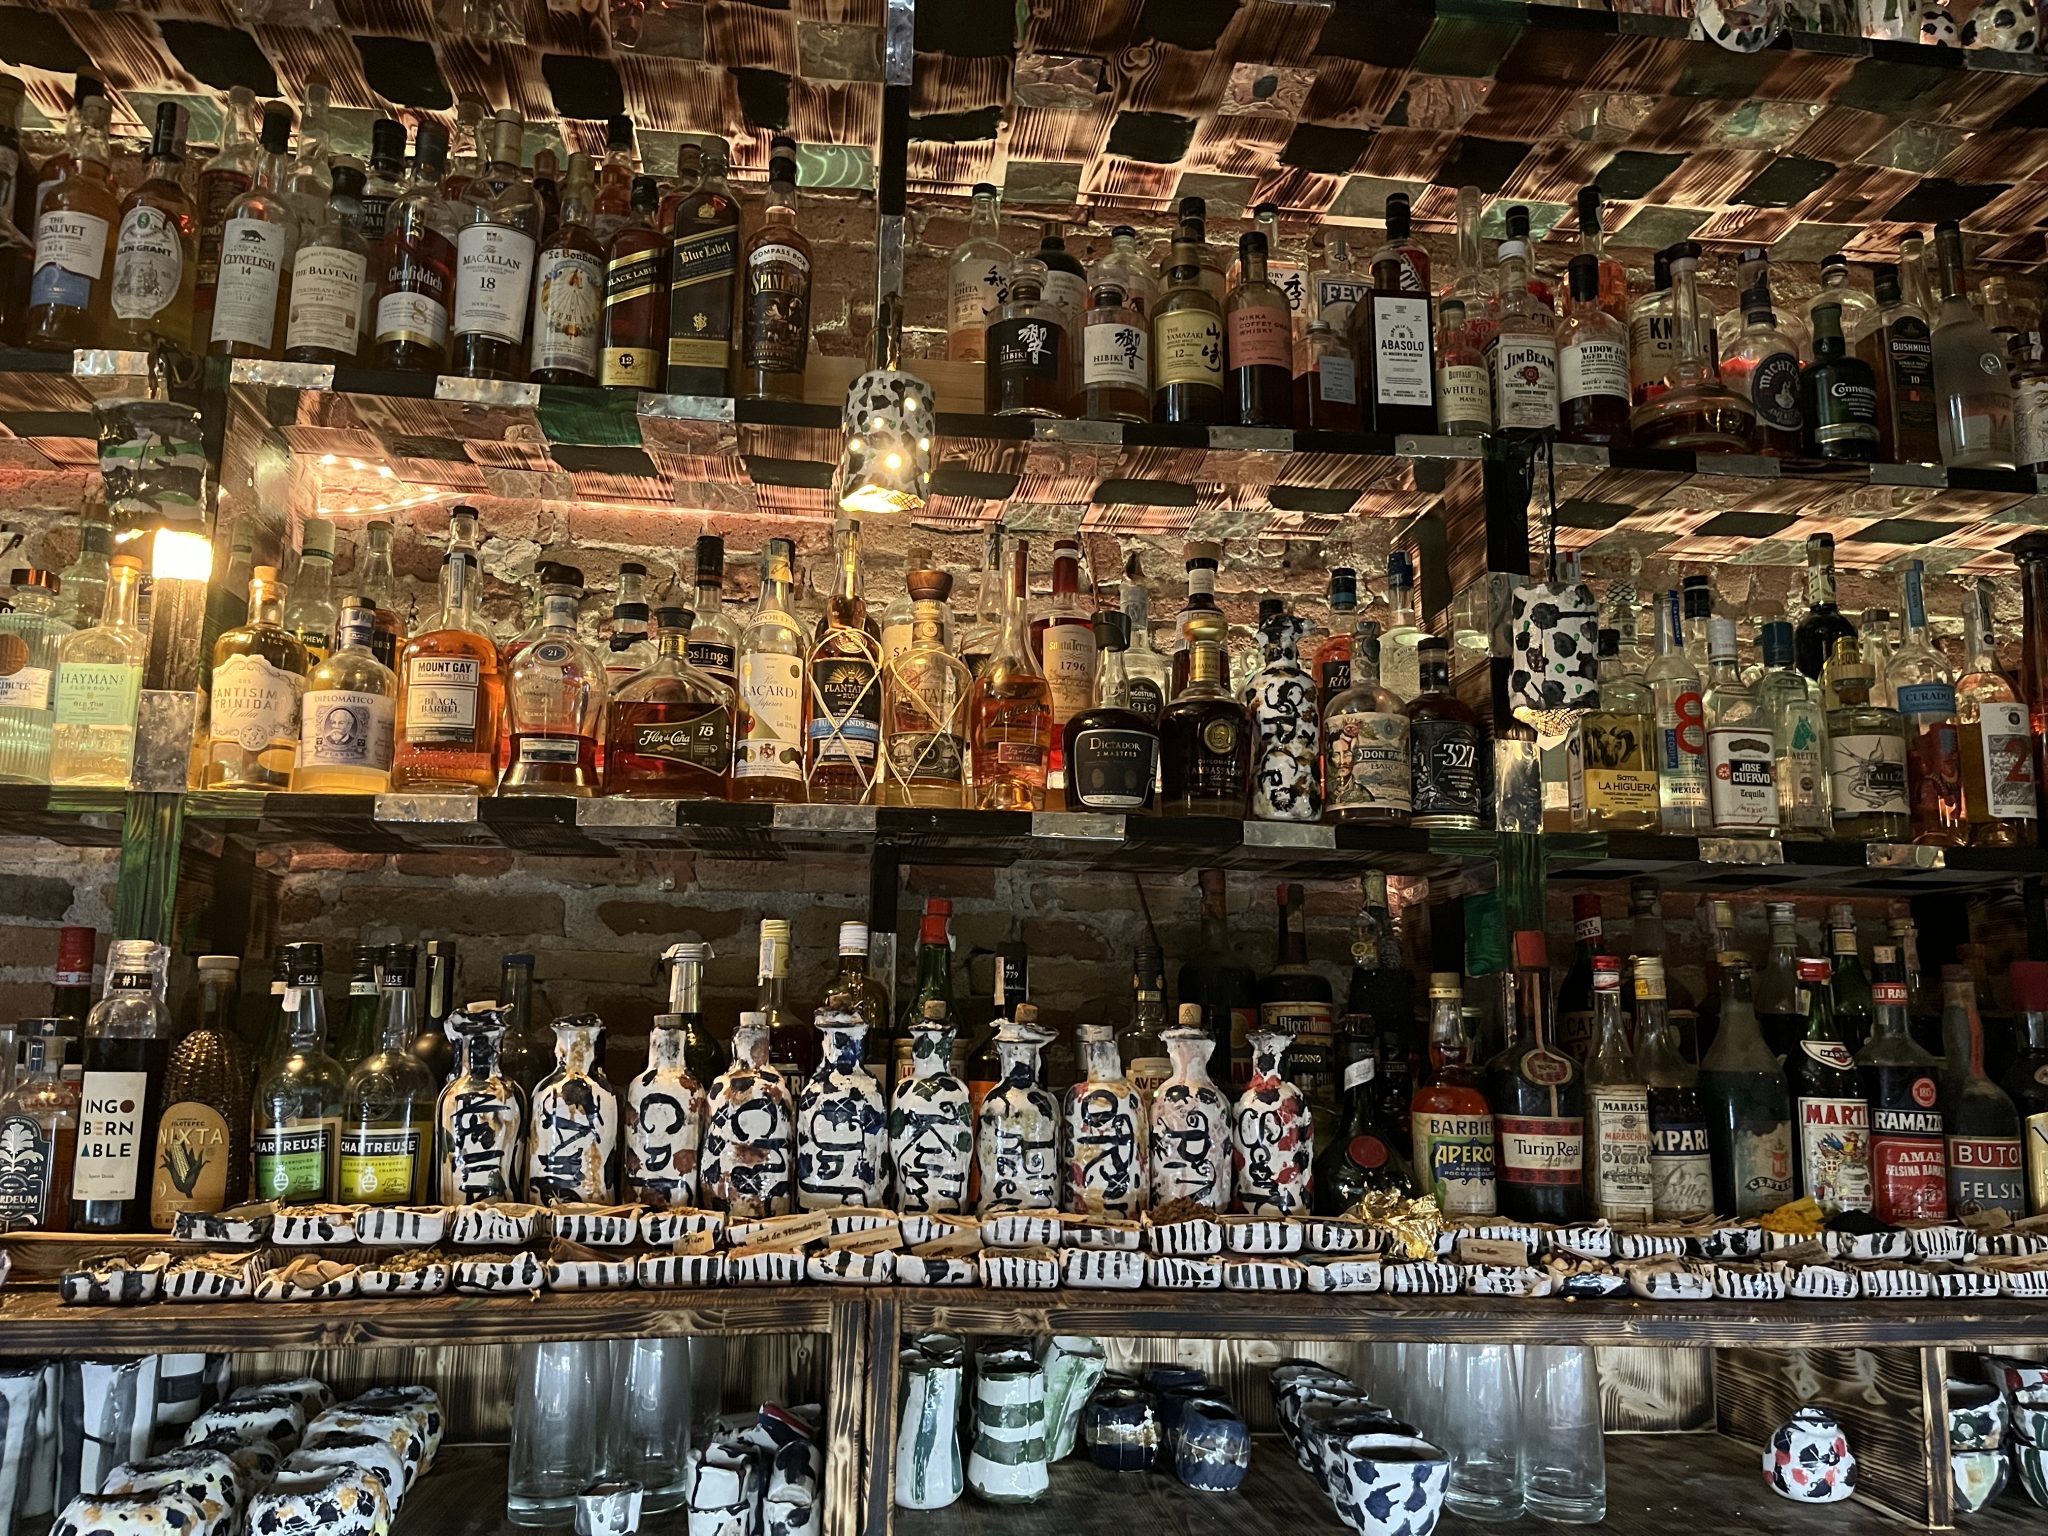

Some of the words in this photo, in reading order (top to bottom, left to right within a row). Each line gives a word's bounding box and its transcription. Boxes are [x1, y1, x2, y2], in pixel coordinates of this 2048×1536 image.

[136, 246, 172, 257] GRANT
[482, 244, 497, 254] The
[680, 250, 703, 265] Blue
[704, 241, 731, 258] Label
[223, 253, 275, 272] CLYNELISH
[463, 254, 521, 270] MACALLAN
[753, 247, 790, 261] COMPASS
[792, 251, 806, 267] BOX
[241, 266, 251, 275] 14
[309, 266, 360, 283] BALVENIE
[607, 272, 632, 287] BLACK
[633, 265, 657, 278] LABEL
[389, 264, 443, 291] Glenfiddich
[480, 277, 496, 290] 18
[954, 285, 979, 297] CHITA
[1240, 313, 1266, 322] NIKKA
[1166, 331, 1204, 341] YAMAZAKI
[1240, 328, 1273, 336] WHISKY
[1001, 344, 1010, 353] 21
[1381, 339, 1424, 352] ABASOLO
[1580, 345, 1612, 354] WIDOW
[1892, 341, 1931, 353] BUSHMILLS
[1175, 348, 1184, 358] 12
[1582, 353, 1603, 361] AGED
[620, 355, 633, 365] 12
[1093, 354, 1123, 364] HIBIKI
[1503, 352, 1525, 371] JIM
[1525, 349, 1556, 373] BEAM
[1910, 375, 1920, 384] 10
[1442, 385, 1475, 396] WHITE
[548, 649, 558, 657] 21
[418, 662, 450, 673] MOUNT
[452, 663, 473, 674] GAY
[1060, 661, 1086, 672] 1796
[453, 673, 470, 681] 1703
[824, 683, 875, 696] PLANTATON
[424, 697, 457, 706] BLACK
[1905, 692, 1951, 702] CURADO
[421, 705, 461, 714] BARREL
[1132, 702, 1157, 713] 919
[1675, 692, 1706, 755] 8
[698, 725, 714, 737] 18
[639, 730, 664, 746] Flor
[670, 729, 691, 746] Caña
[1090, 737, 1141, 751] DICTADOR
[1666, 729, 1678, 768] TEQUILA
[1364, 750, 1386, 759] DON
[1442, 743, 1475, 768] 327
[2004, 737, 2031, 783] 2
[1740, 763, 1761, 772] JOSE
[1616, 774, 1640, 782] SOTOL
[1732, 772, 1771, 783] CUERVO
[1598, 781, 1611, 790] LA
[1613, 782, 1657, 792] HIGUERA
[1740, 789, 1766, 800] Tequila
[1005, 963, 1015, 971] dal
[122, 974, 137, 988] #1
[159, 1128, 224, 1145] NIXTA
[341, 1139, 416, 1153] CHARTREUSE
[1513, 1138, 1555, 1156] Turin
[1559, 1141, 1580, 1157] Real
[1958, 1145, 2021, 1164] BUTO
